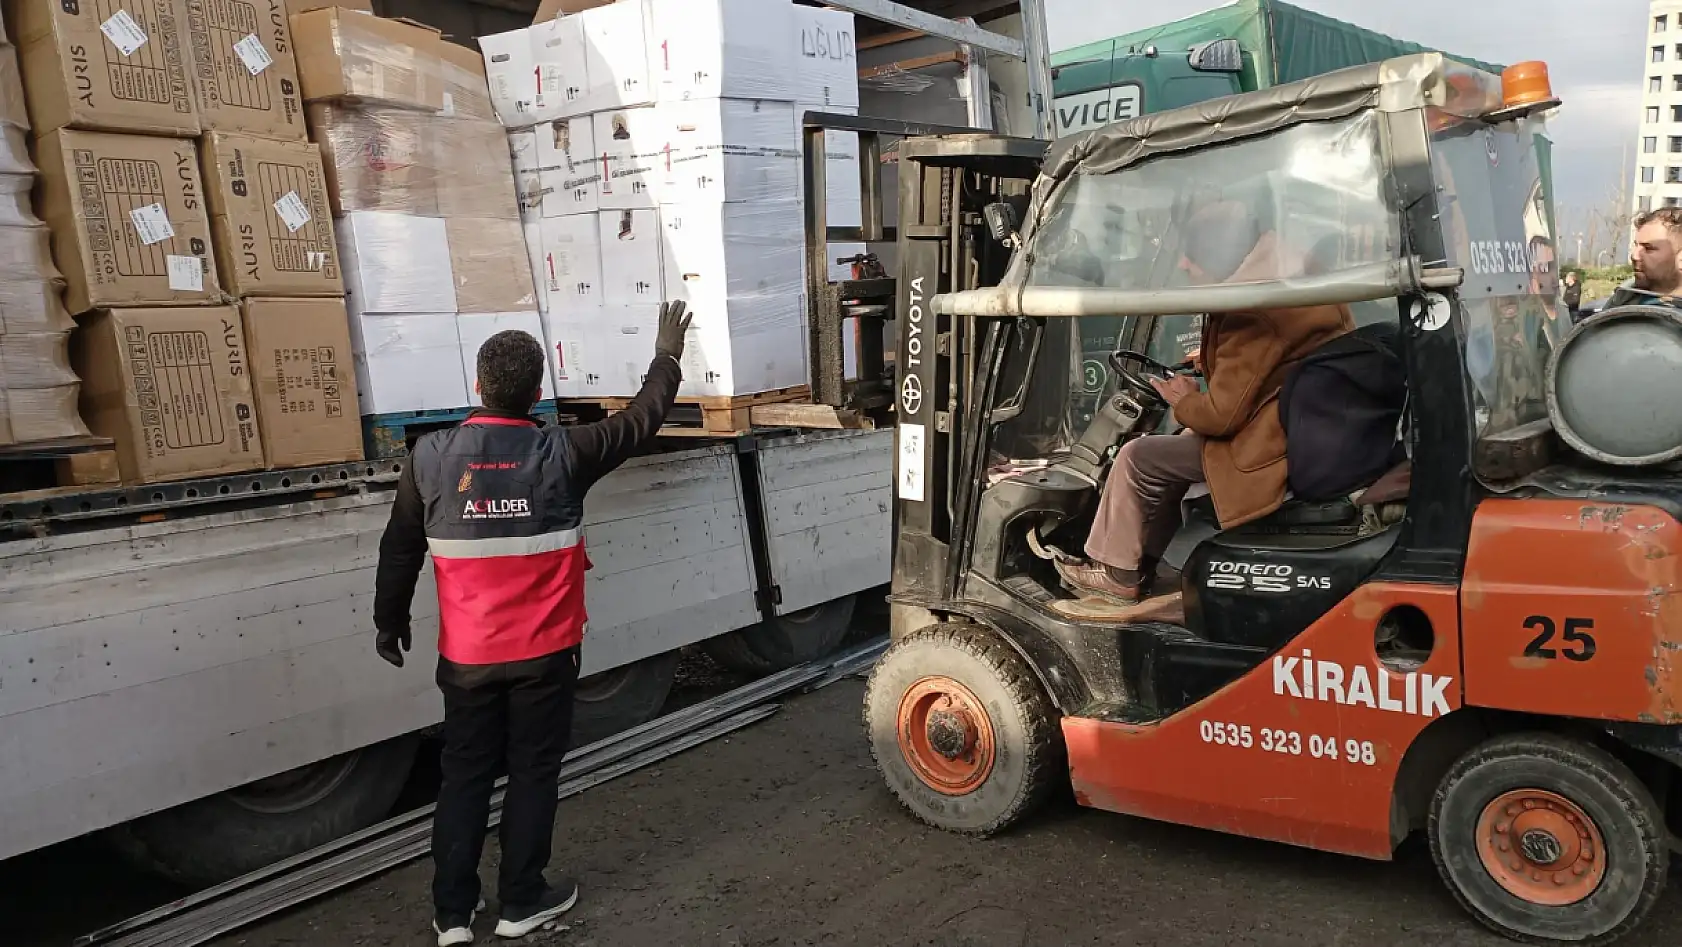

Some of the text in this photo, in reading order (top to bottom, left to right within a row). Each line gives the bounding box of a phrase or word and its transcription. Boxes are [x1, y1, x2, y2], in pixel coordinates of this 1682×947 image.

[269, 0, 287, 54] AURIS
[71, 45, 95, 108] AURIS
[1059, 97, 1134, 128] VICE
[174, 151, 197, 210] AURIS
[232, 180, 247, 197] 8
[239, 224, 260, 281] AURIS
[1470, 240, 1505, 274] 0535
[1505, 240, 1527, 273] 323
[908, 276, 924, 368] TOYOTA
[221, 318, 243, 377] AURIS
[1085, 367, 1097, 385] 3
[235, 403, 250, 421] 8
[1206, 574, 1331, 592] 25 SAS
[1209, 561, 1293, 575] TONERO
[1522, 615, 1597, 662] 25
[1273, 648, 1454, 718] KİRALIK
[1200, 720, 1376, 765] 0535 323 04 98
